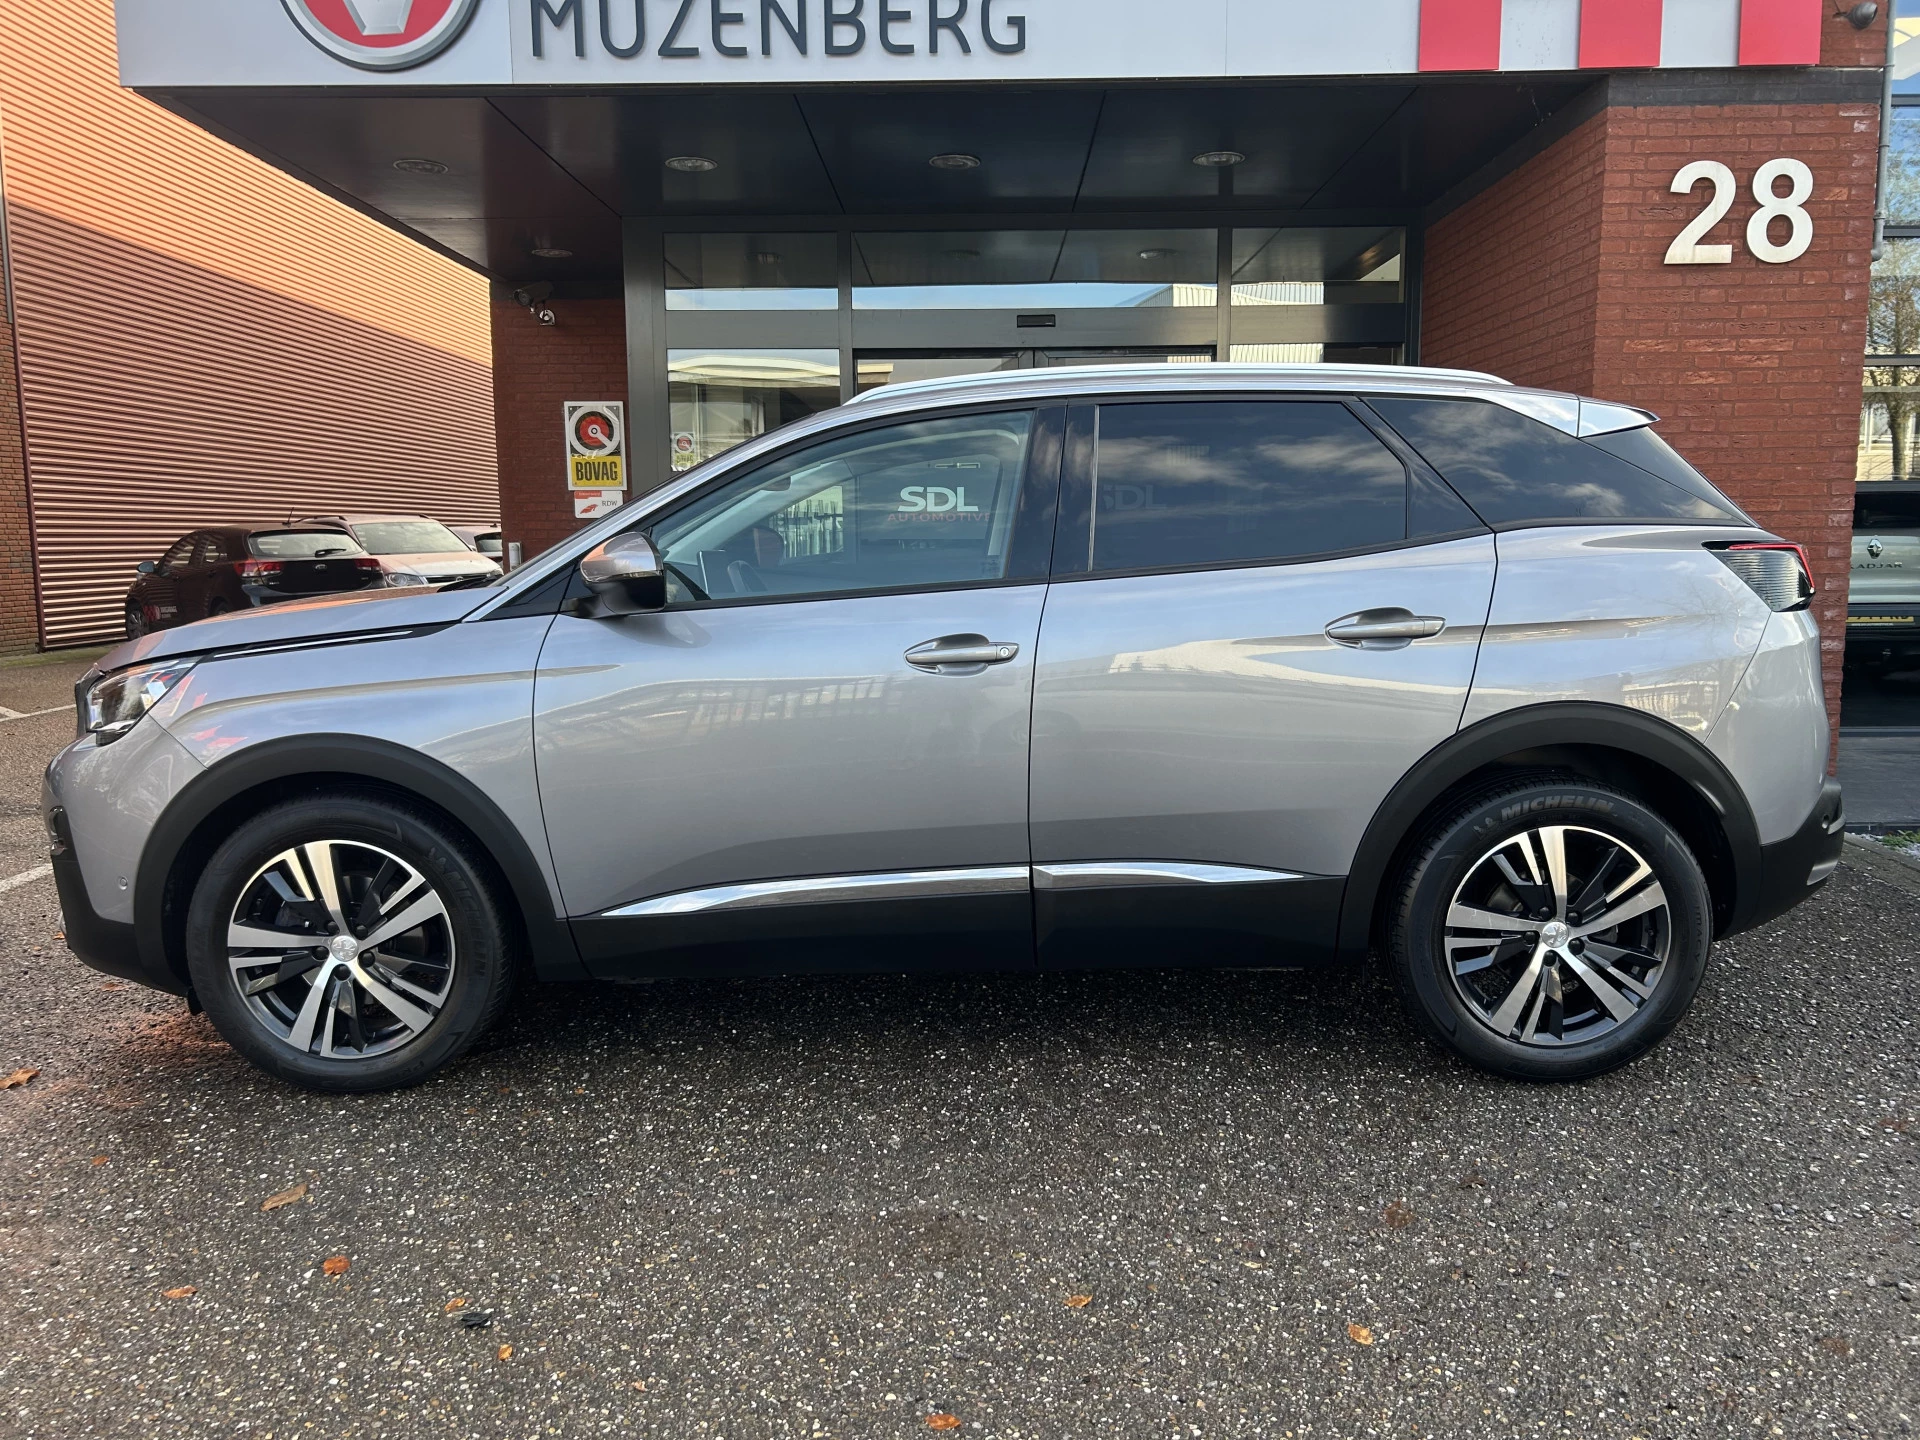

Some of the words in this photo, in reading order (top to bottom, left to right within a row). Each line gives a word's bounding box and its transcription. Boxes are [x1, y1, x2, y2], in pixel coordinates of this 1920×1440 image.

[533, 0, 1027, 57] MUZENBERG
[1664, 157, 1814, 264] 28
[575, 460, 618, 481] BOVAG
[897, 485, 979, 512] SDL
[1501, 795, 1615, 821] MICHELIN
